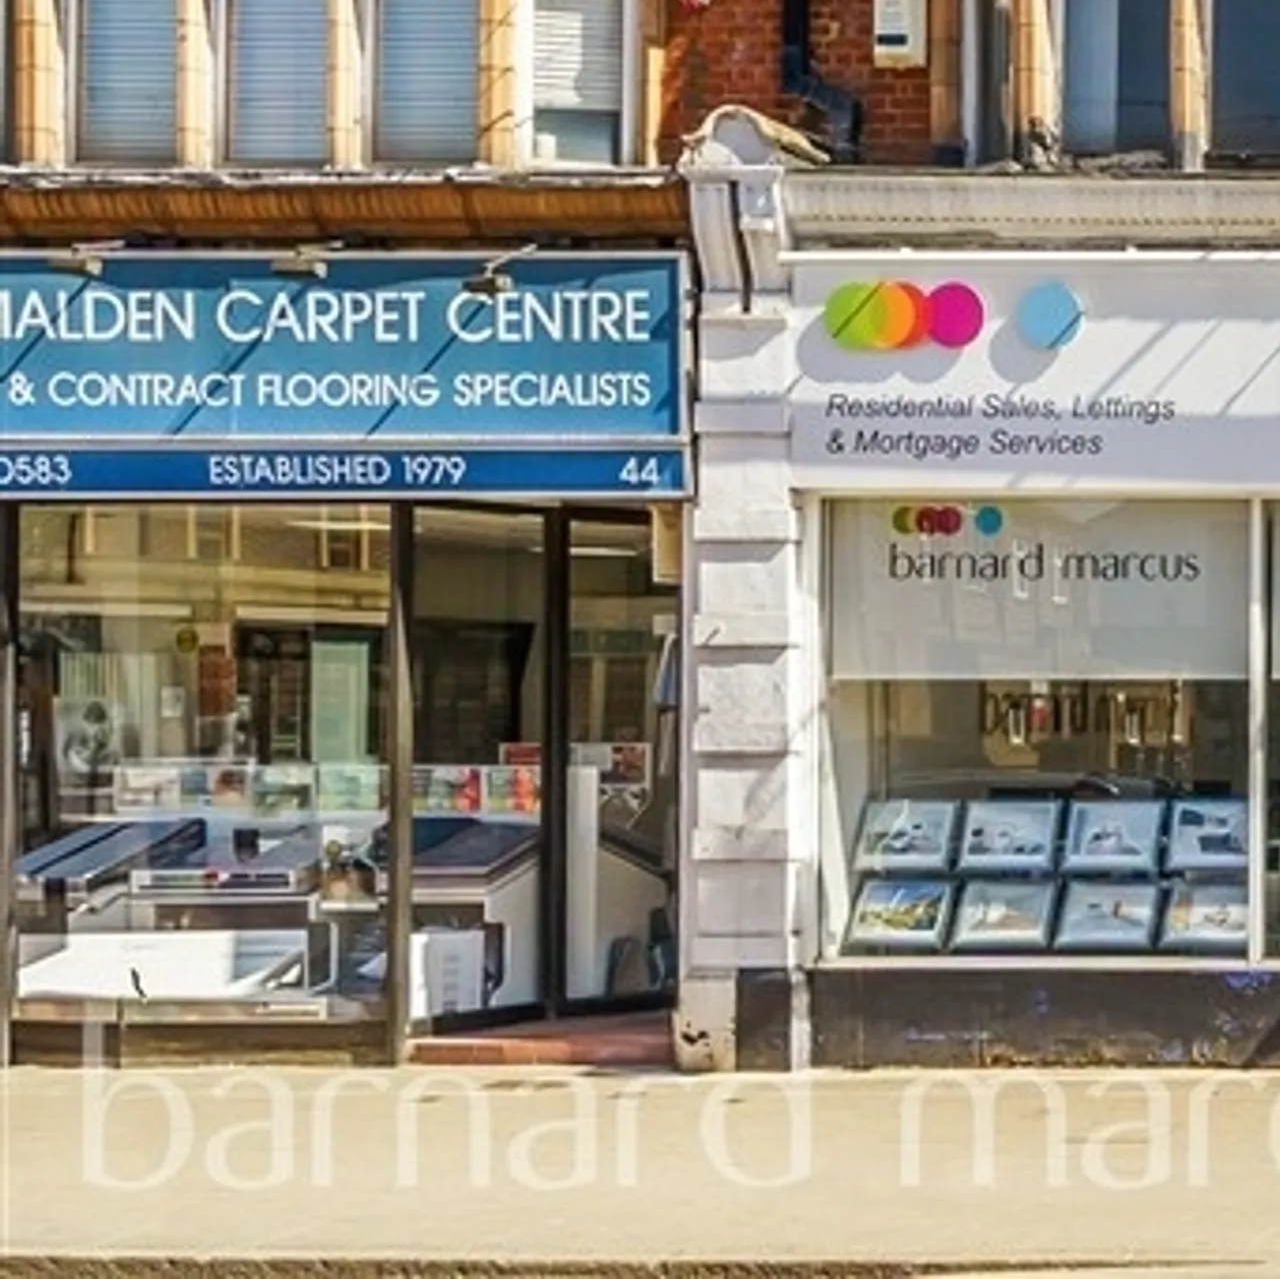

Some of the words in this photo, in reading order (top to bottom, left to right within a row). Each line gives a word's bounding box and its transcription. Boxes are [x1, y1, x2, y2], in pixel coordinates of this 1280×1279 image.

[0, 288, 196, 342] ALDEN
[216, 290, 425, 343] CARPET
[447, 290, 651, 343] CENTRE
[9, 371, 36, 407] &
[48, 371, 245, 408] CONTRACT
[258, 372, 440, 408] FLOORING
[453, 372, 651, 408] SPECIALISTS
[825, 393, 973, 419] Residential
[981, 393, 1061, 421] Sales,
[1071, 393, 1176, 425] Lettings
[825, 427, 845, 455] &
[853, 429, 980, 460] Mortgage
[988, 428, 1103, 455] Services
[209, 456, 392, 484] ESTABLISHED
[401, 455, 466, 485] 1979
[618, 456, 660, 484] 44
[888, 542, 1045, 581] barnard
[1060, 551, 1201, 581] marcus
